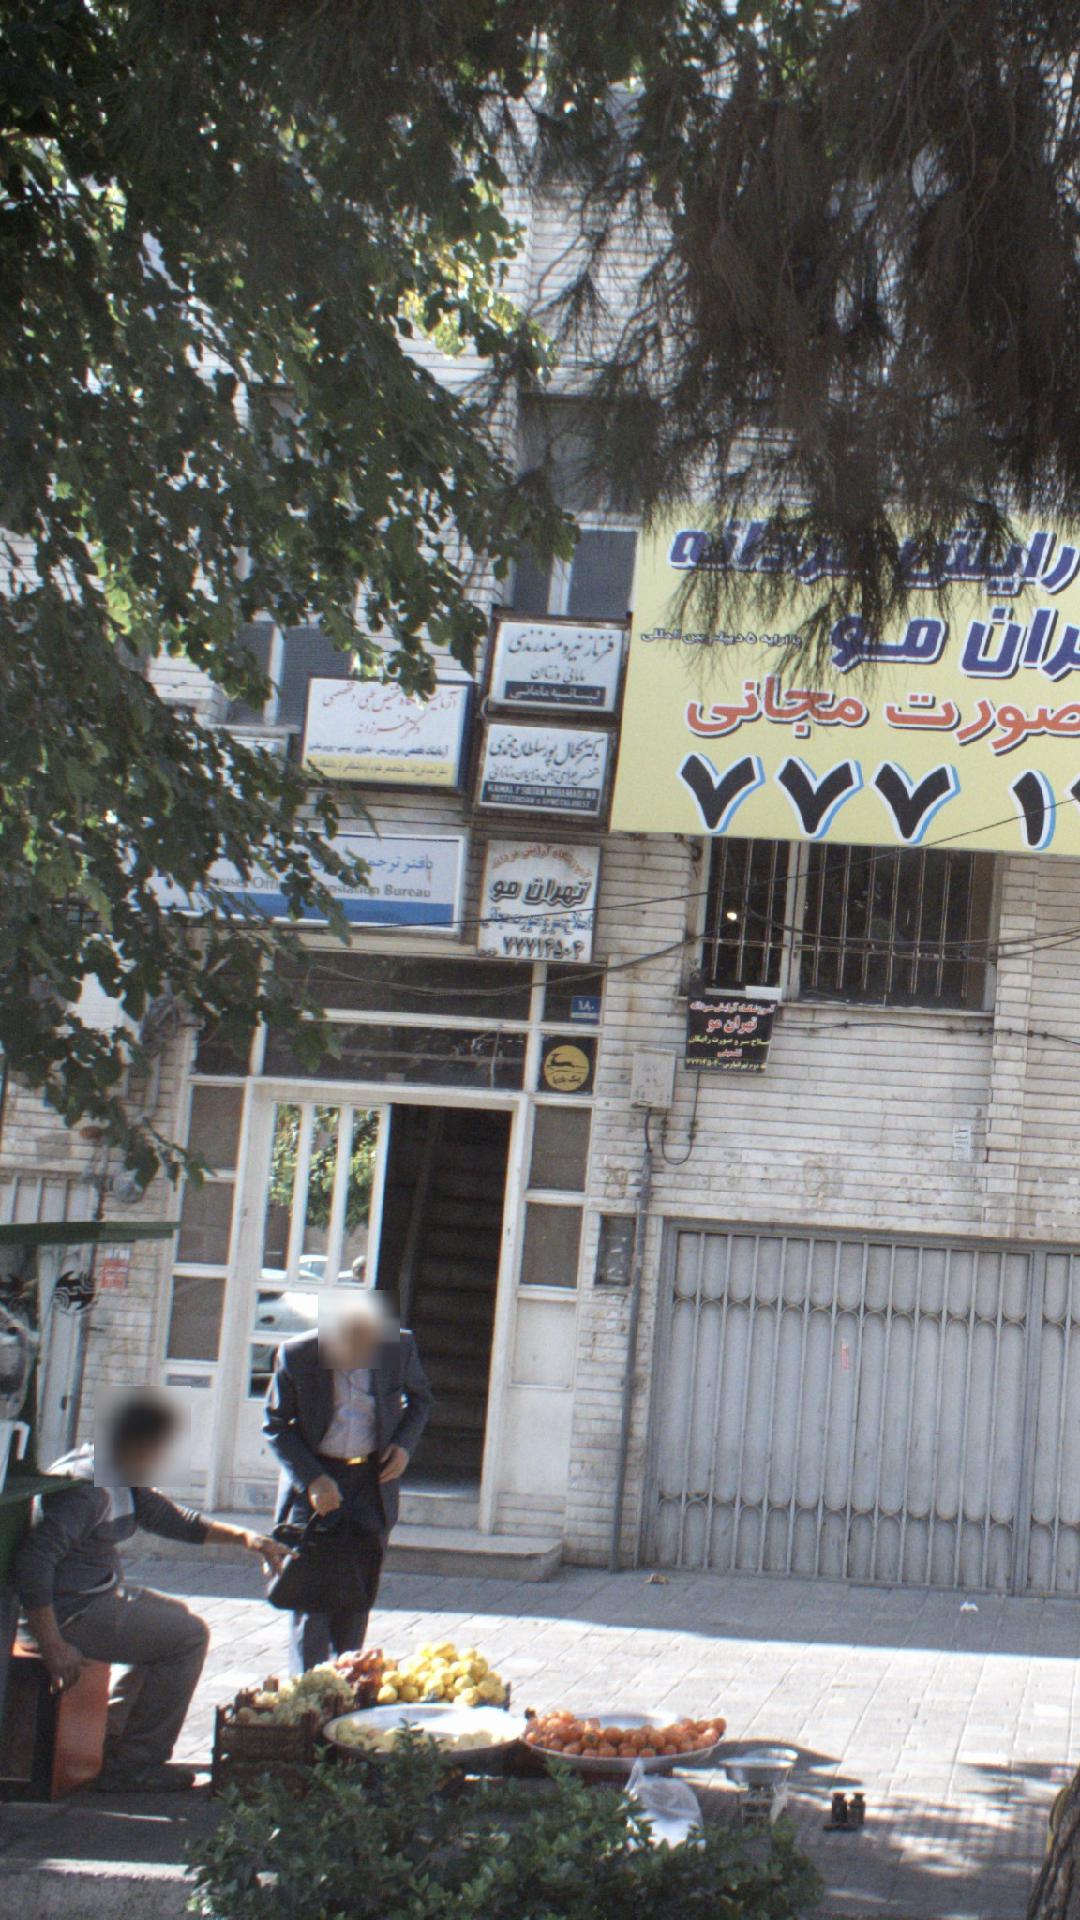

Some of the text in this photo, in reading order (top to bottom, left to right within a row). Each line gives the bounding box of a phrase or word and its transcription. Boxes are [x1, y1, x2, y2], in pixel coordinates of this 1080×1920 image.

[830, 613, 947, 673] مو
[685, 673, 869, 738] مجانی
[384, 884, 431, 899] Bureau
[489, 877, 592, 908] تهران مو
[706, 1015, 758, 1035] تهران مو
